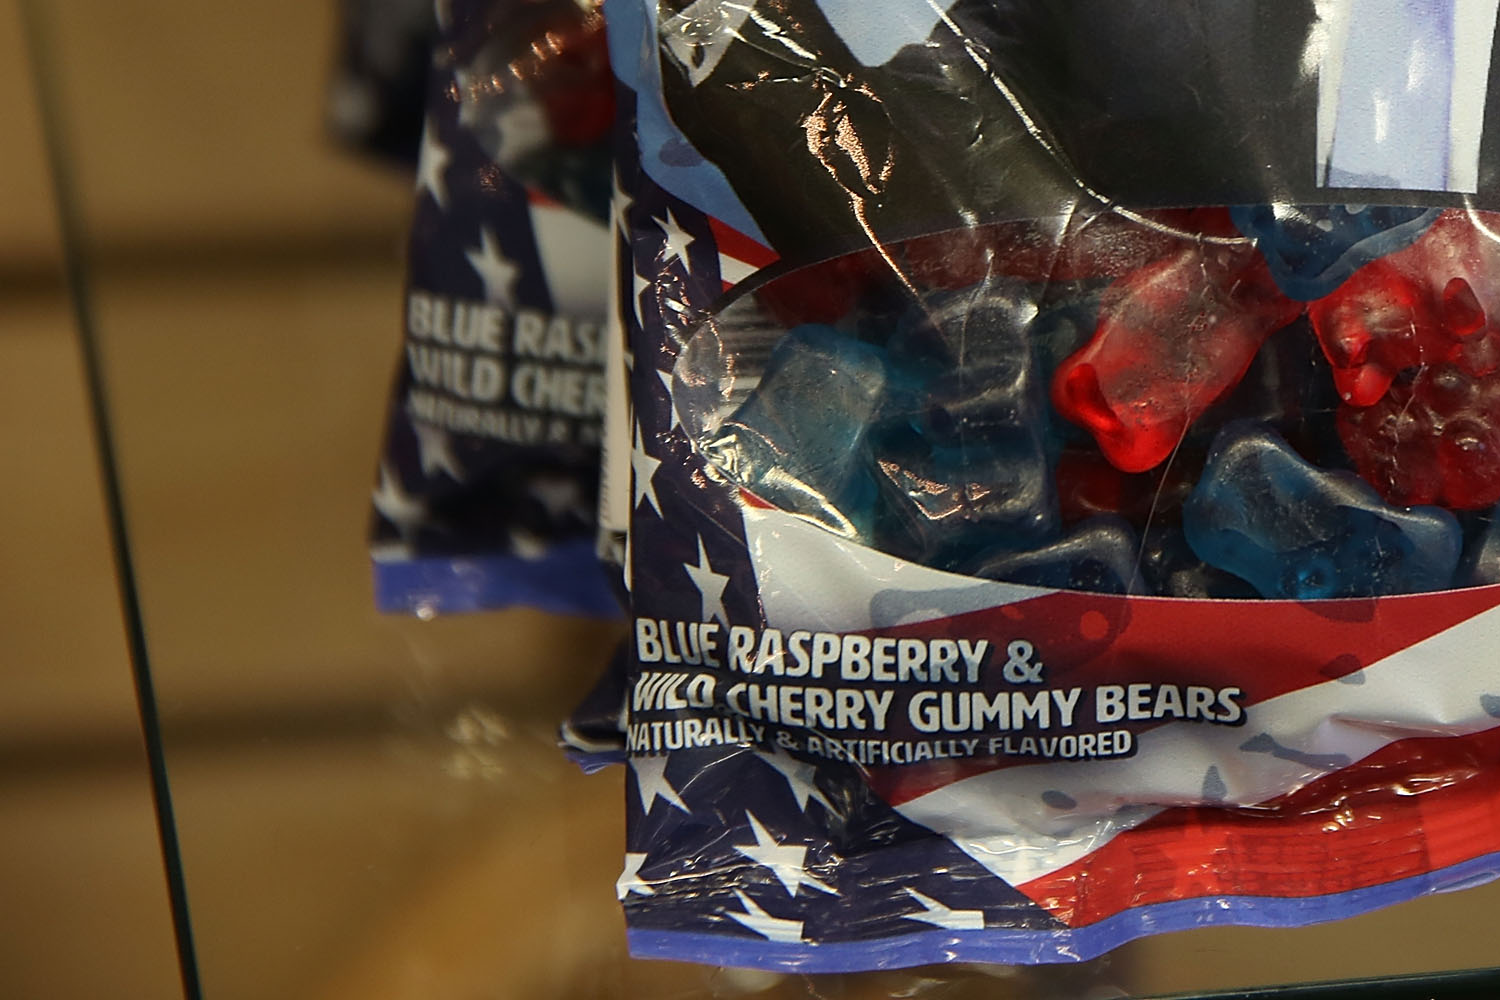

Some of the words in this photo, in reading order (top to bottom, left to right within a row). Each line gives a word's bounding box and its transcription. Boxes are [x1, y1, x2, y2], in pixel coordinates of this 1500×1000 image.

[408, 293, 504, 351] BLUE
[406, 342, 504, 401] WILD
[635, 617, 721, 669] BLUE
[727, 625, 989, 683] RASPBERRY
[1002, 640, 1044, 684] &
[632, 671, 717, 712] WILD
[726, 682, 895, 732] CHERRY
[908, 686, 1082, 734] GUMMY
[1096, 683, 1244, 724] BEARS
[626, 717, 765, 752] NATURALLY
[776, 730, 799, 749] &
[807, 736, 980, 765] ARTIFICIALLY
[988, 730, 1133, 758] FLAVORED
